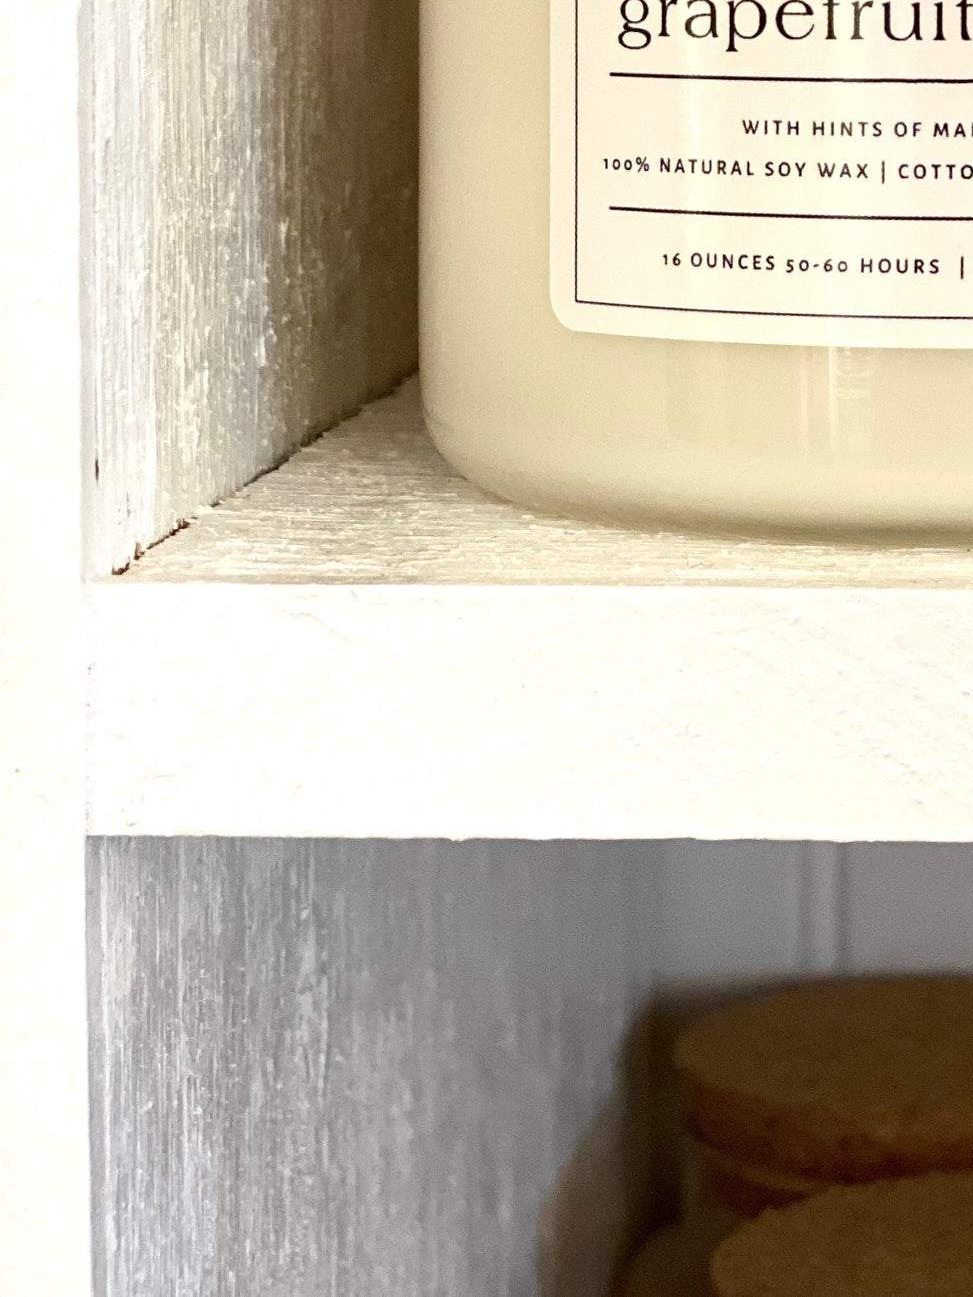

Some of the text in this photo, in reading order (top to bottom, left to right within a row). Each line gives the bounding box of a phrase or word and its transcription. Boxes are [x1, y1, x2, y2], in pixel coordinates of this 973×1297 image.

[741, 118, 800, 136] WITH
[811, 120, 883, 138] HINTS
[893, 121, 923, 139] OF
[602, 155, 650, 174] 100%
[659, 156, 755, 177] NATURAL
[764, 160, 807, 178] SOY
[816, 161, 869, 179] WAX
[661, 252, 682, 267] 16
[690, 251, 776, 271] OUNCES
[785, 258, 849, 274] 50-60
[860, 257, 940, 275] HOURS
